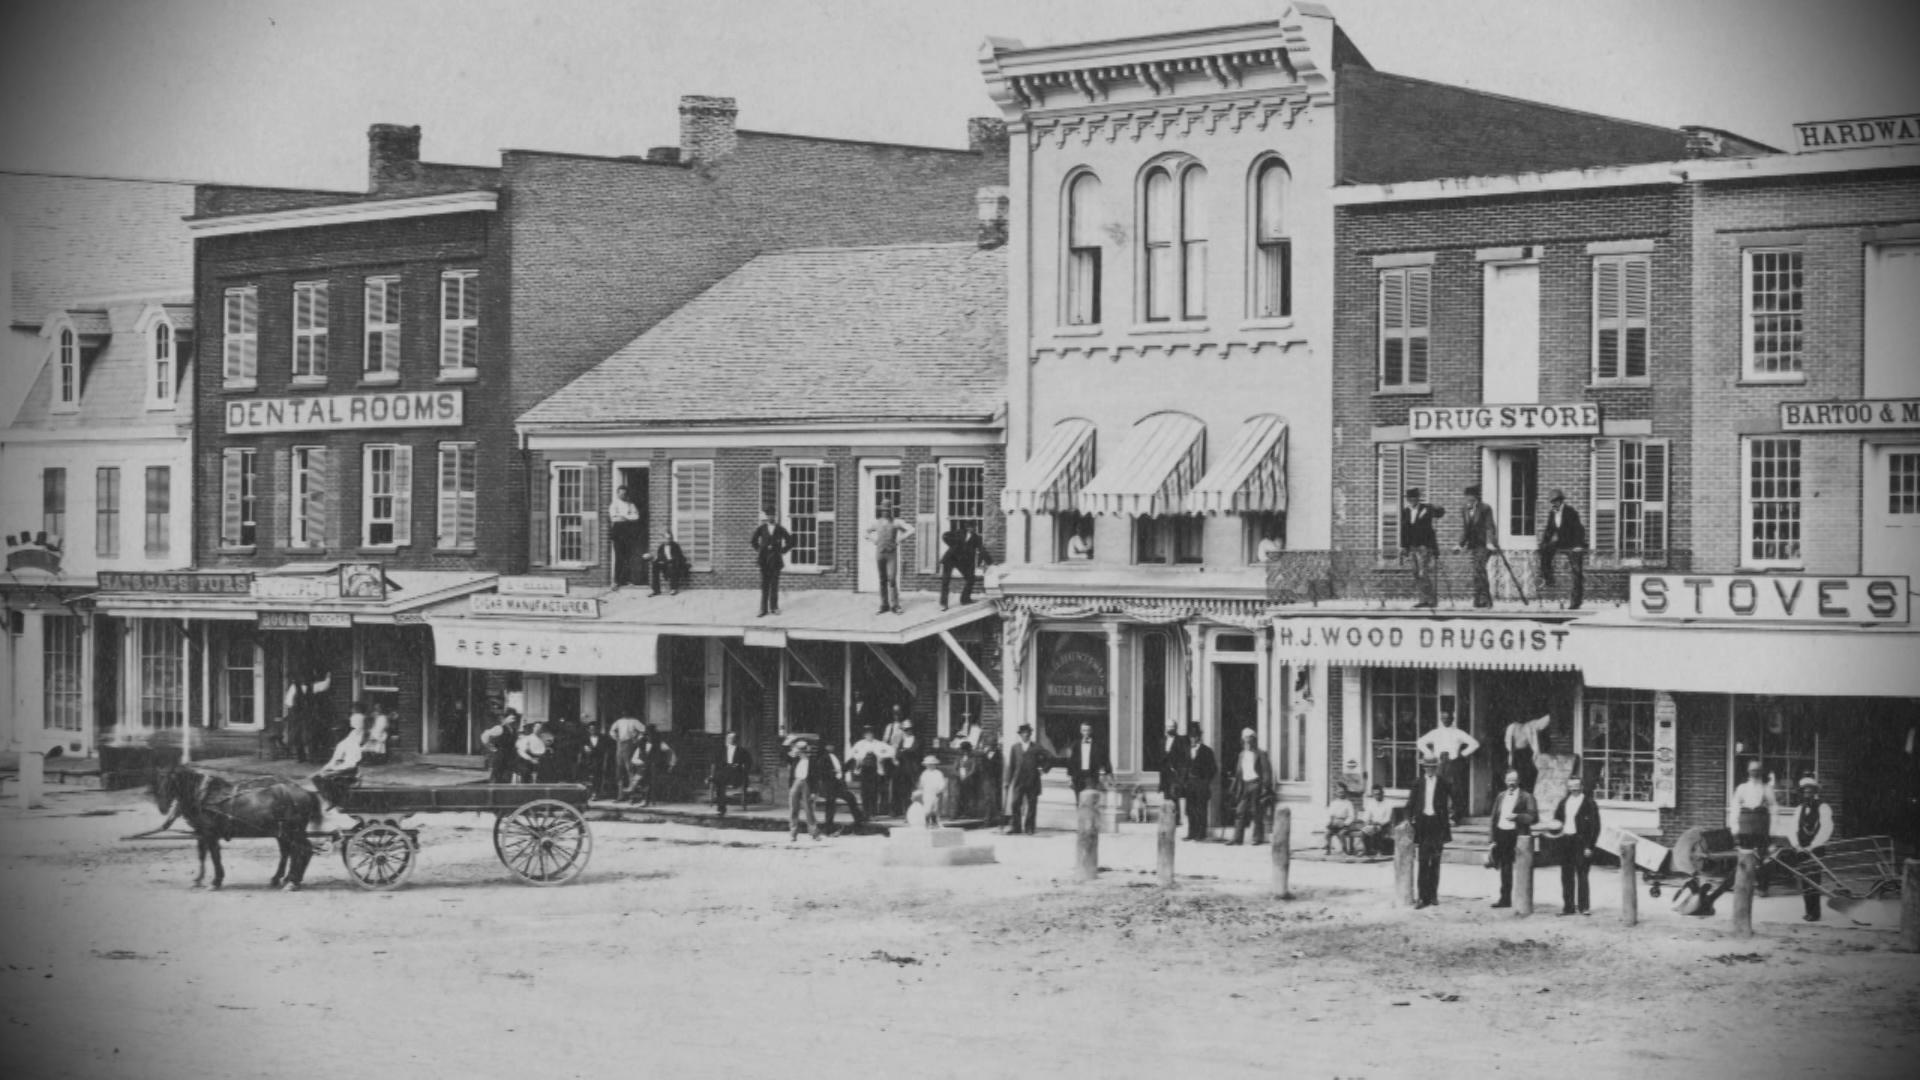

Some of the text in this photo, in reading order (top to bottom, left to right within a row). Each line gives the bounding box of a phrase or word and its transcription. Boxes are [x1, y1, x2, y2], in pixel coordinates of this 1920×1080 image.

[229, 399, 343, 428] DENTAL
[1414, 406, 1597, 430] DRUG STORE
[1786, 404, 1873, 425] BARTOO
[1880, 403, 1895, 423] &
[197, 575, 247, 593] FURS
[1641, 577, 1898, 618] STOVES
[1420, 627, 1570, 651] DRUGGIST
